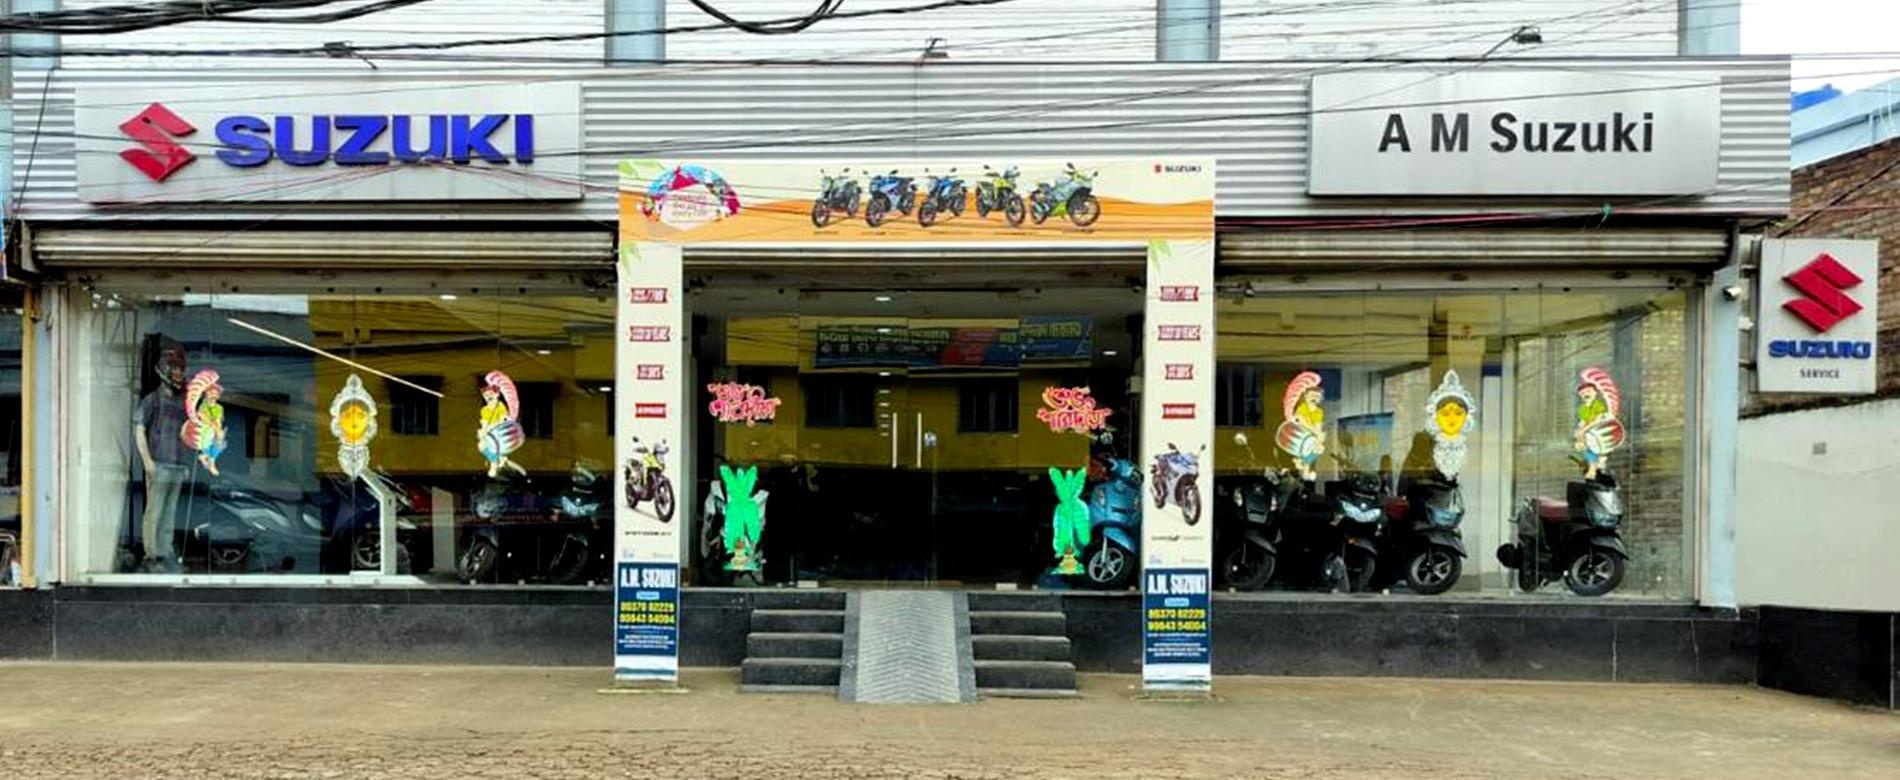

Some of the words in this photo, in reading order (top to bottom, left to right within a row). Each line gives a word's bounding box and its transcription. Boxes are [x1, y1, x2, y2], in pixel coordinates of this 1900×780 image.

[215, 114, 533, 167] SUZUKI
[1378, 113, 1410, 152] A
[1432, 113, 1469, 152] M
[1490, 111, 1654, 153] Suzuki
[1164, 164, 1201, 173] SUZUKI
[1769, 340, 1871, 359] SUZUKI
[1800, 369, 1840, 378] SERVICE
[642, 568, 676, 588] SUZUKI
[1170, 574, 1206, 596] SUZUKI
